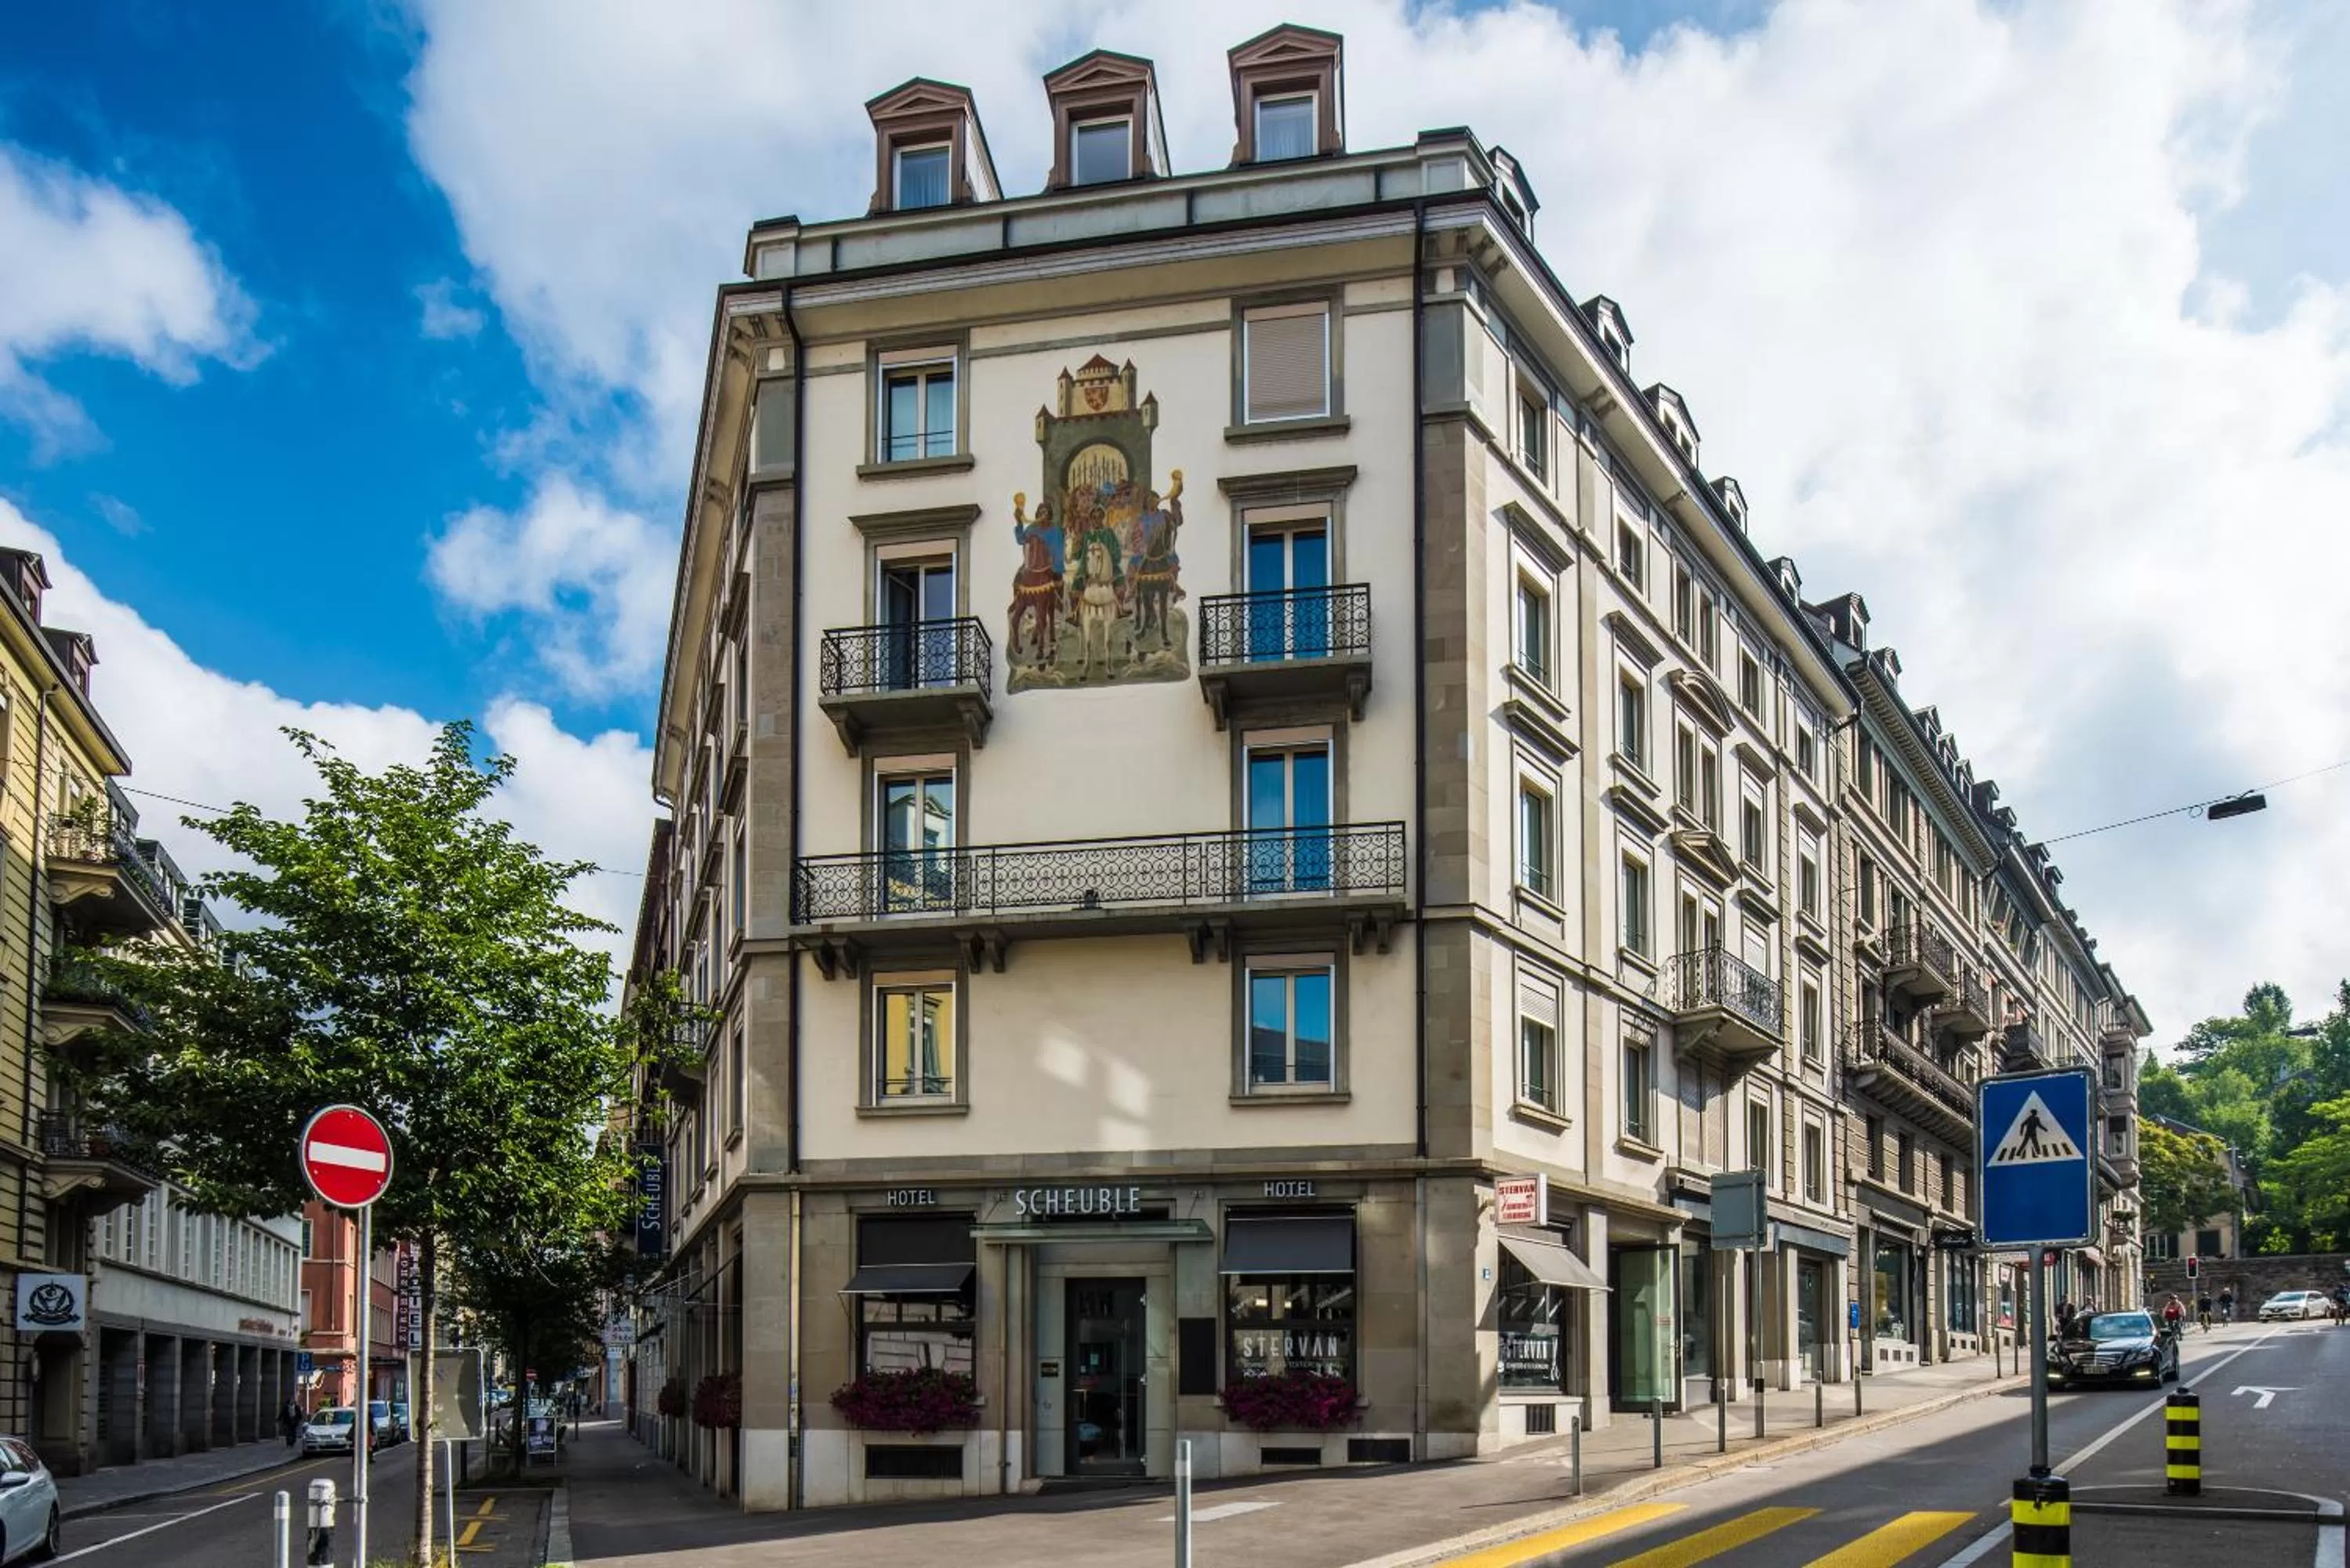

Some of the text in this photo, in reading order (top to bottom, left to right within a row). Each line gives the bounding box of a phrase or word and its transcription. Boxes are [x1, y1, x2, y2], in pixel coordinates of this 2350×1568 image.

[642, 1157, 661, 1230] SCHEUBL
[887, 1190, 936, 1206] HOTEL
[1015, 1186, 1141, 1215] SCHEUBLE
[1264, 1182, 1315, 1197] HOTEL
[1242, 1335, 1337, 1357] STERVAN
